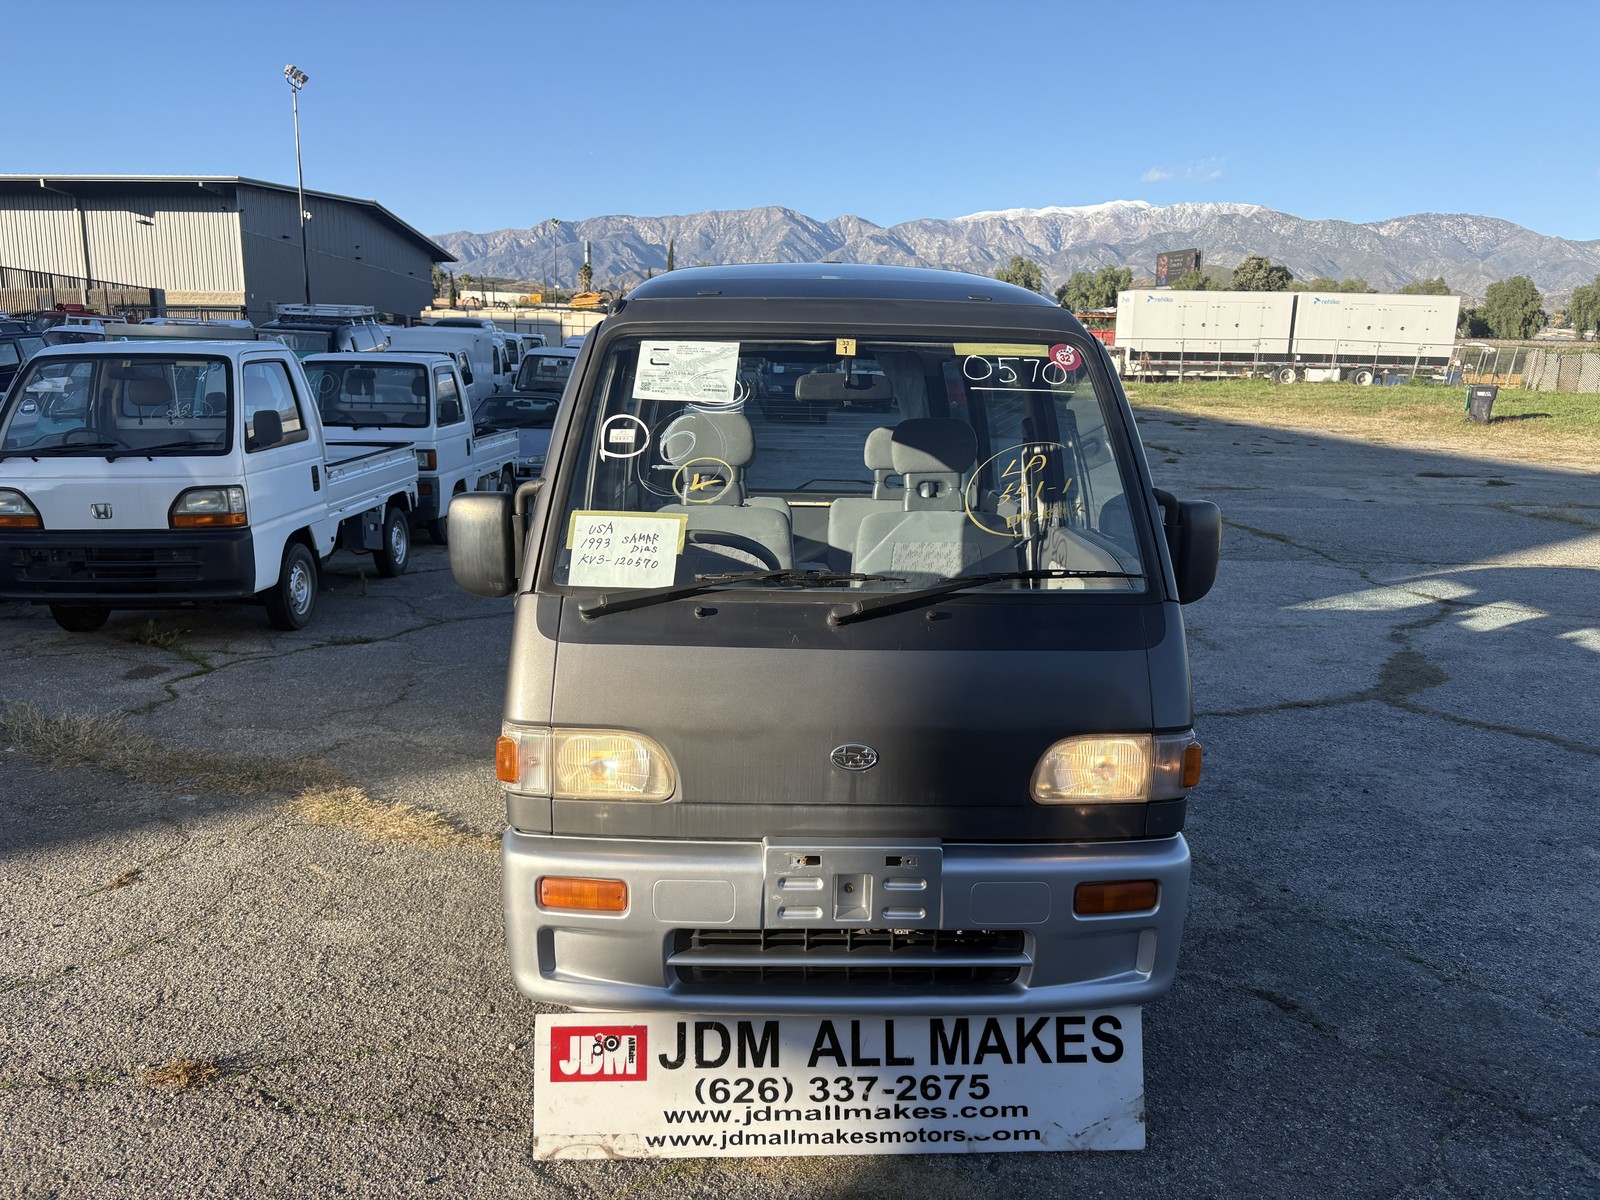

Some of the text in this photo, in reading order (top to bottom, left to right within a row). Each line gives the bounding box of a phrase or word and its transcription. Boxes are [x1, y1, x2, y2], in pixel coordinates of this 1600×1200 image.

[963, 354, 1068, 384] 0570
[1060, 354, 1071, 363] 32
[588, 521, 614, 535] USA
[580, 537, 611, 550] 1993
[559, 1035, 637, 1075] JDM
[658, 1015, 1124, 1070] JDM ALL MAKES
[695, 1074, 990, 1105] (626) 337-2675
[663, 1104, 1029, 1126] www.jdmallmakes.com
